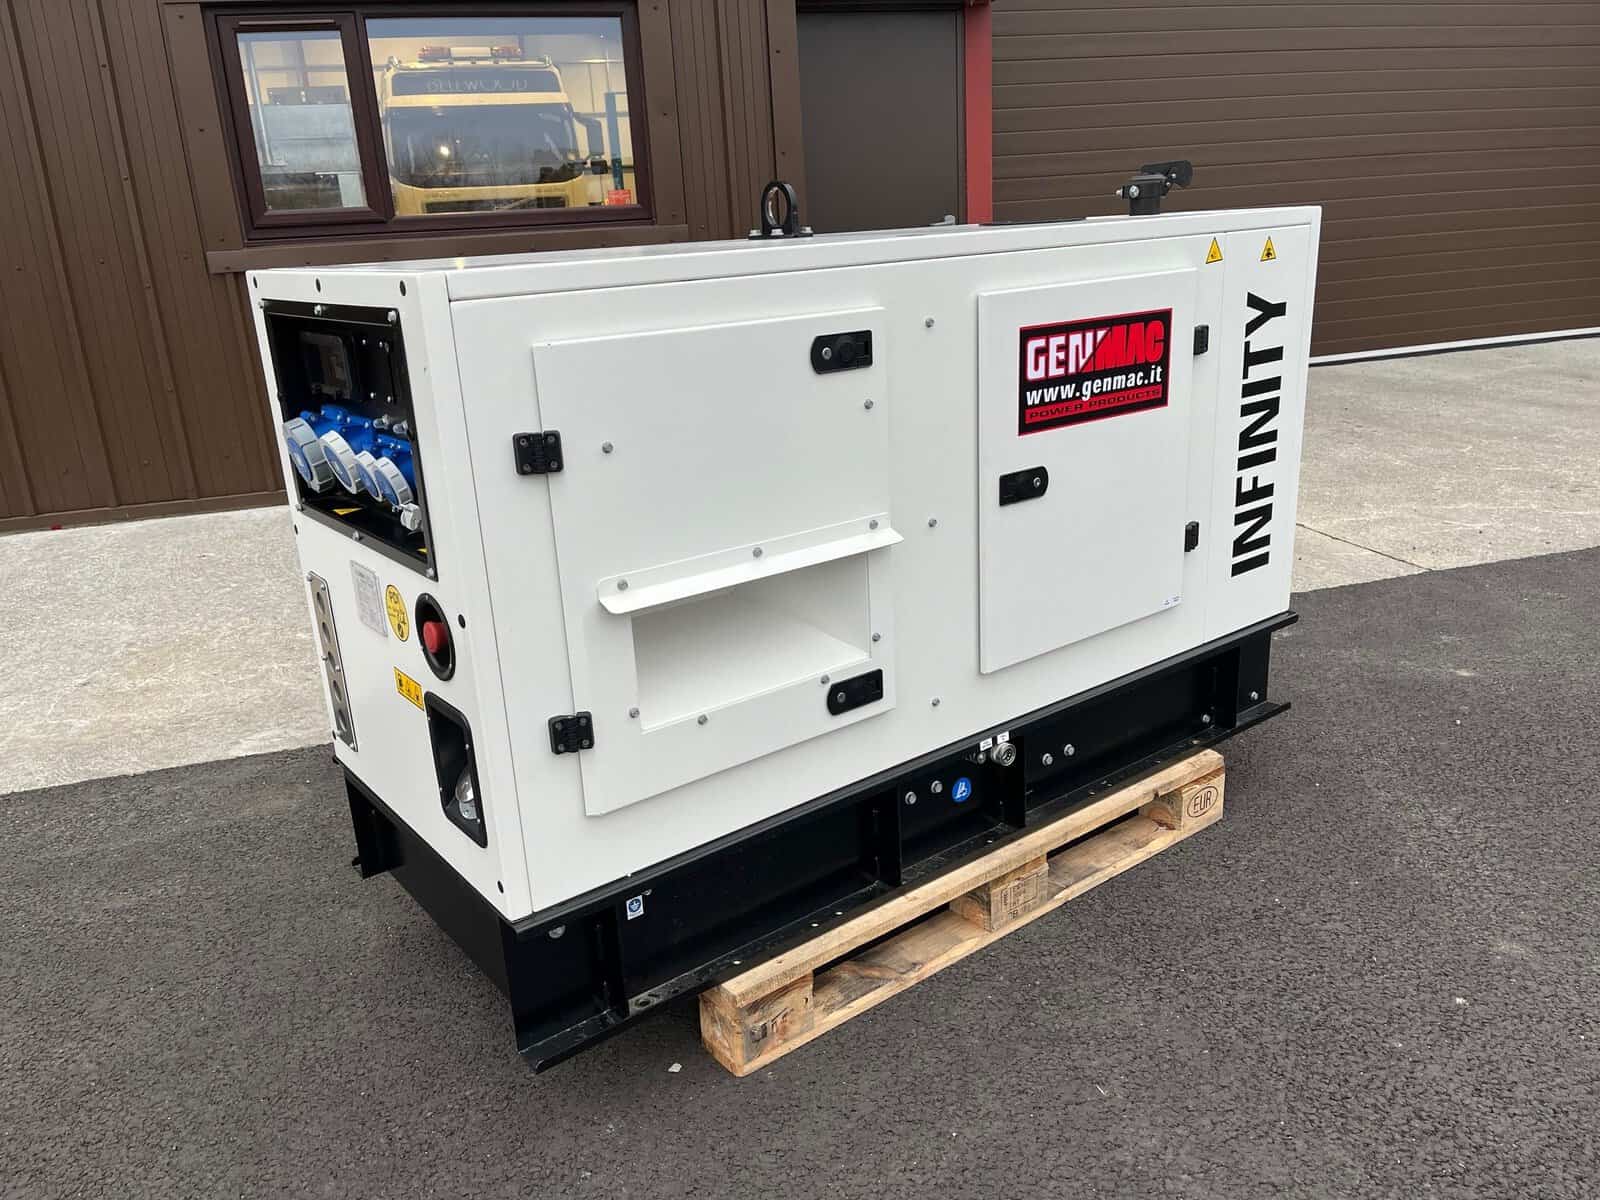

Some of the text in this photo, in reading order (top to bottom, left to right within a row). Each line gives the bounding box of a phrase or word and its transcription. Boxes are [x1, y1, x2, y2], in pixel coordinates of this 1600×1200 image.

[1027, 320, 1165, 381] GENMAC
[1026, 365, 1163, 406] www.genmac.it
[1030, 389, 1160, 418] POWER PRODUCTS
[1231, 291, 1287, 578] INFINITY
[1194, 790, 1212, 814] EUR
